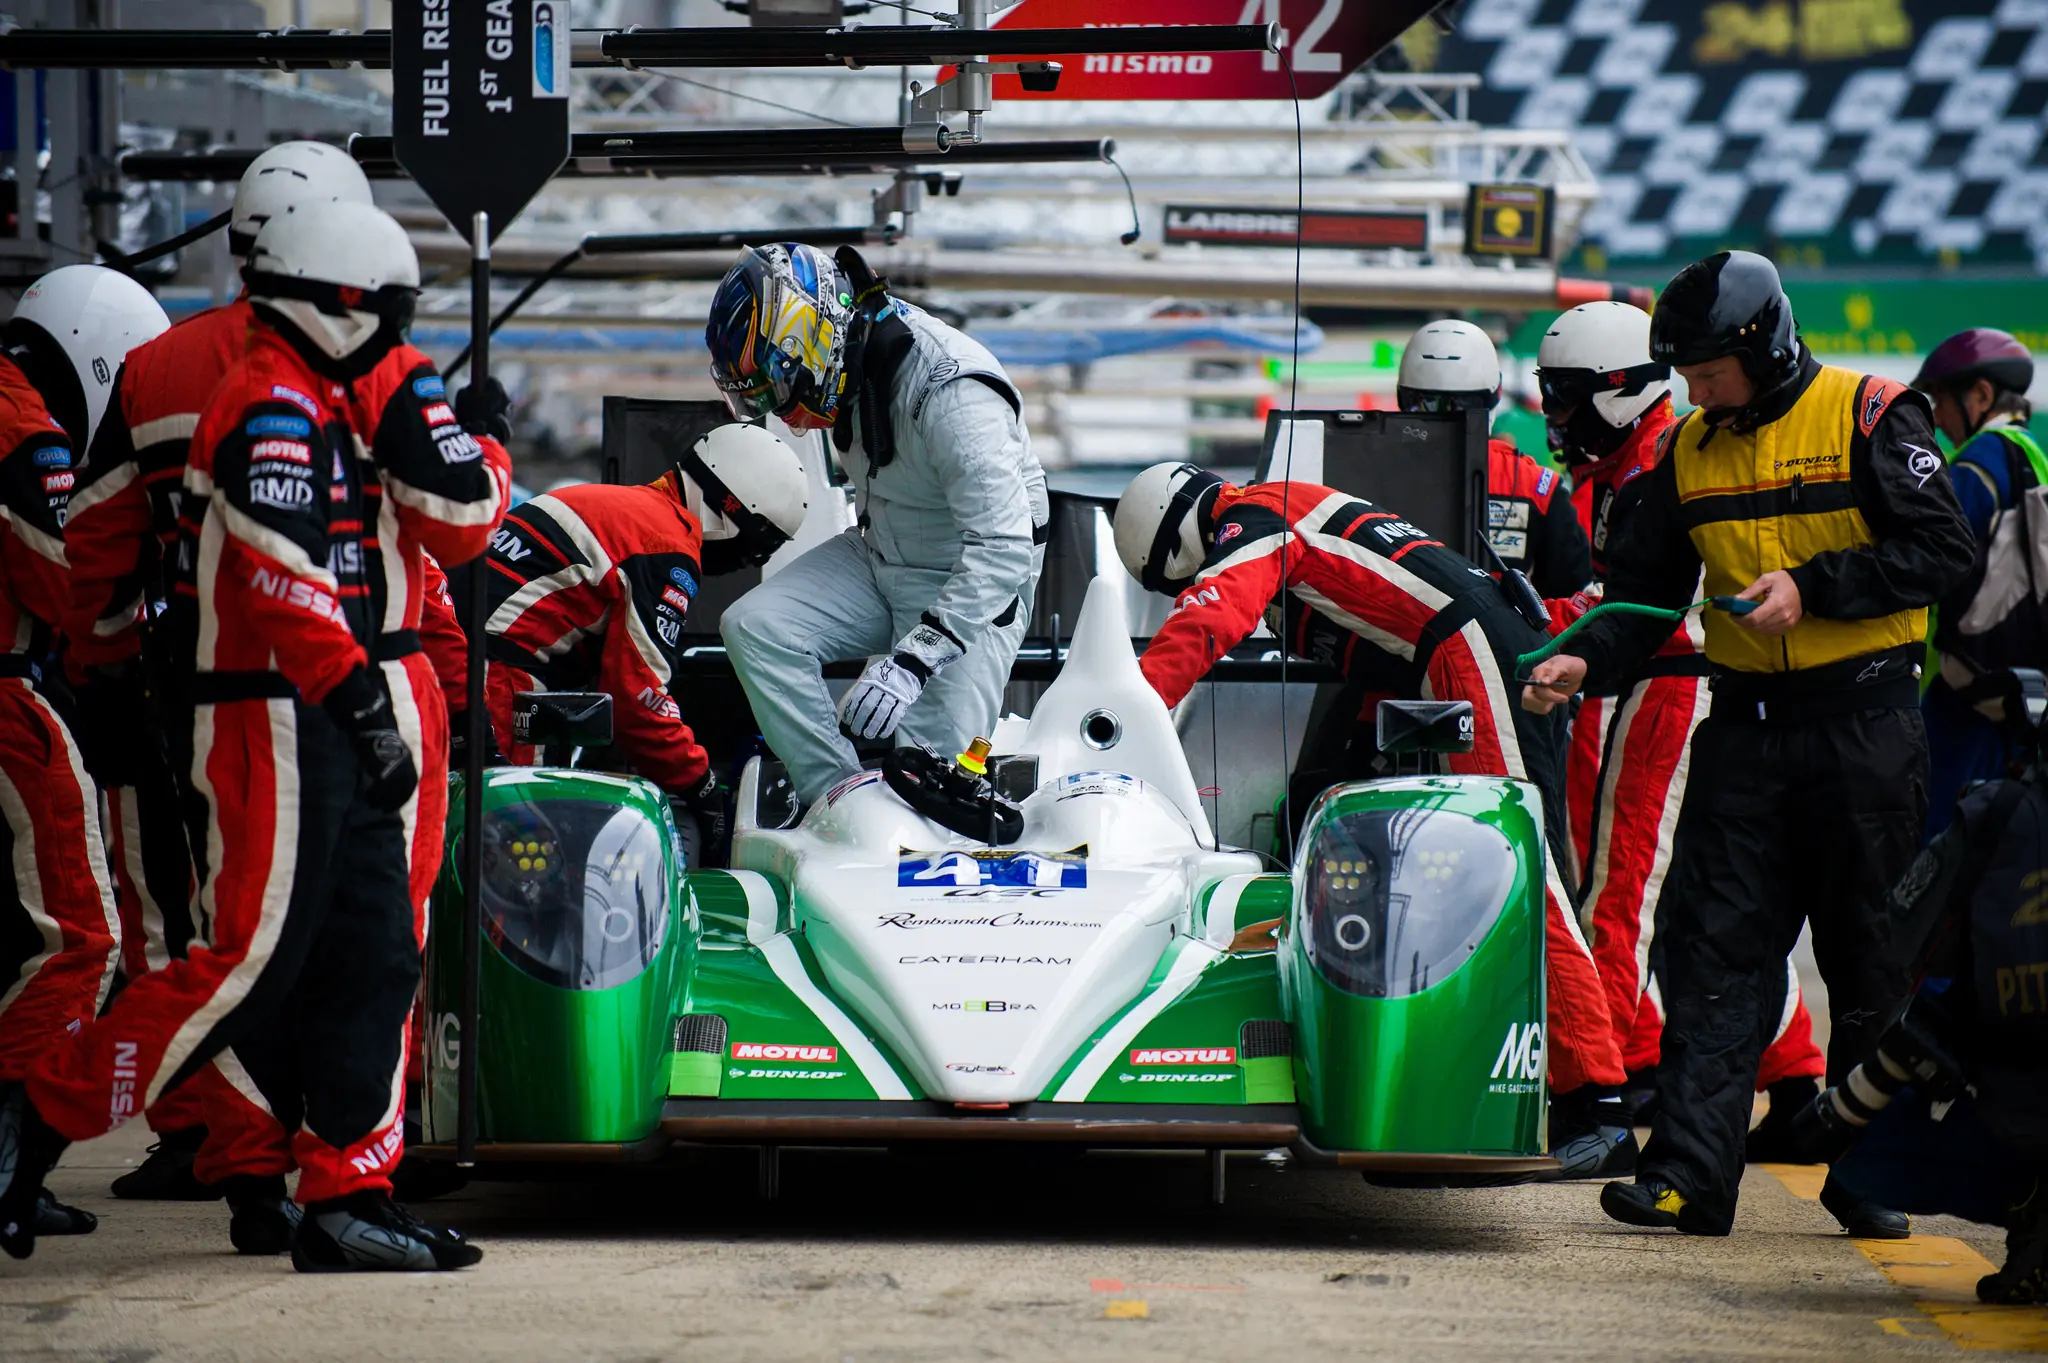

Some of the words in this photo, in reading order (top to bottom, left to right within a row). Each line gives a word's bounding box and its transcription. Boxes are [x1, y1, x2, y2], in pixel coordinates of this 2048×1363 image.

[1083, 55, 1213, 74] nismo
[423, 60, 449, 136] FUEL
[251, 440, 311, 462] MOTUL
[1785, 455, 1842, 468] DUNLOP
[247, 461, 314, 479] DUNLOP
[874, 912, 1102, 930] RembrandtCharms.com
[899, 955, 1072, 966] CATERHAM
[1997, 963, 2048, 1016] PIT
[736, 1044, 833, 1060] MOTUL
[1135, 1049, 1231, 1063] MOTUL
[747, 1069, 843, 1079] DUNLOP
[1137, 1073, 1231, 1082] DUNLOP
[1489, 1083, 1506, 1094] MIKE
